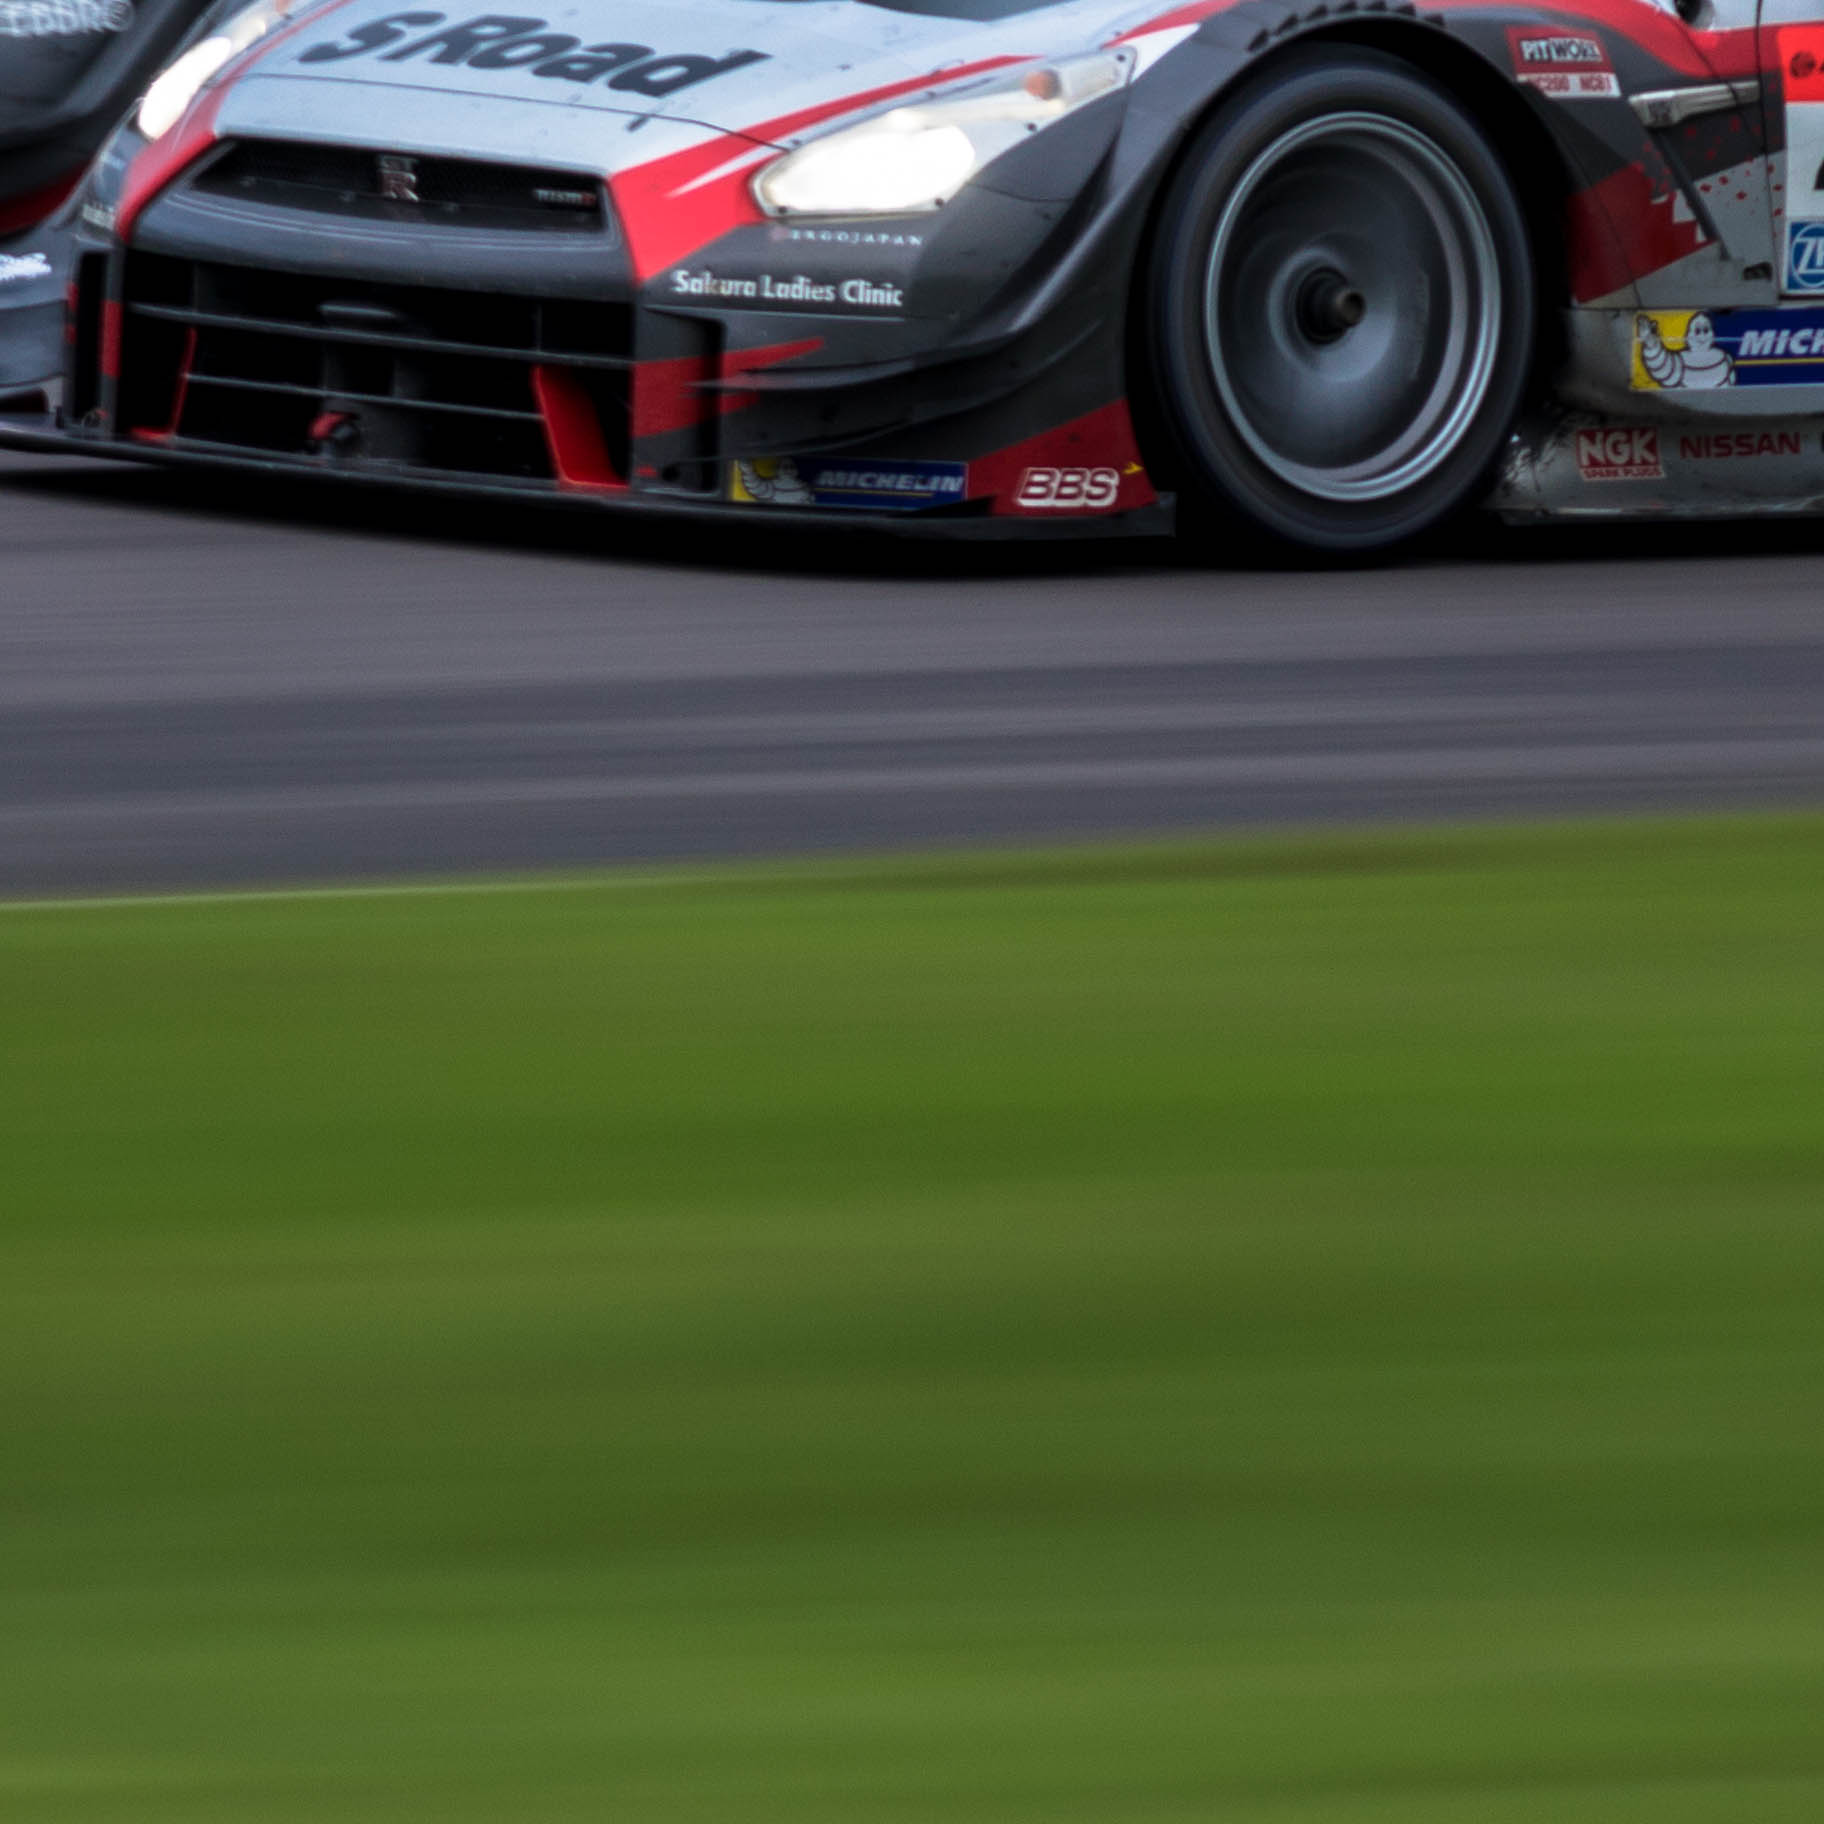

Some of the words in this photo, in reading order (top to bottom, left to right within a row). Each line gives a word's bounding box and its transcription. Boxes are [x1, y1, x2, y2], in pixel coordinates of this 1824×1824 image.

[299, 11, 447, 64] S
[381, 14, 773, 97] Road
[673, 270, 756, 298] Sakura
[762, 275, 836, 303] Ladies
[842, 279, 904, 308] Clinic
[1578, 430, 1660, 467] NGK
[1680, 431, 1802, 460] NISSAN
[817, 469, 964, 495] MICHELIN
[1016, 467, 1121, 507] BBS
